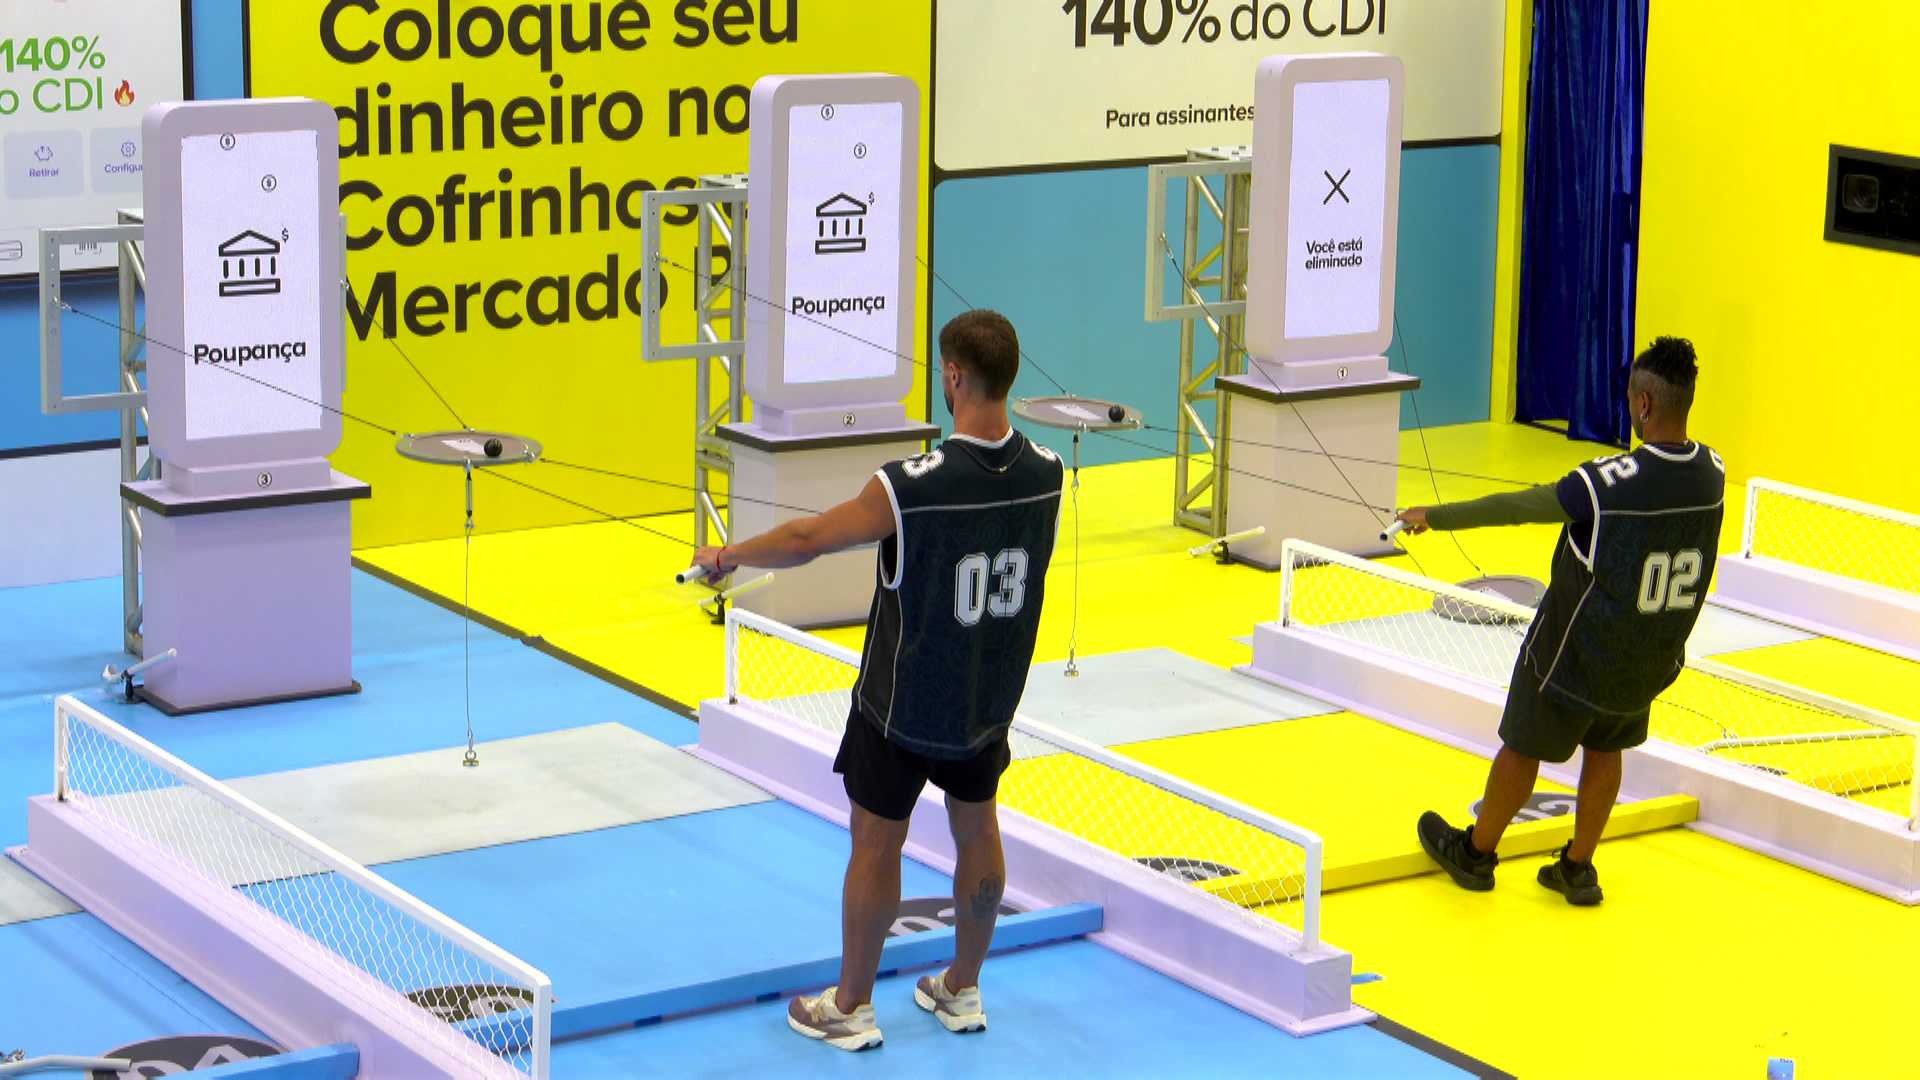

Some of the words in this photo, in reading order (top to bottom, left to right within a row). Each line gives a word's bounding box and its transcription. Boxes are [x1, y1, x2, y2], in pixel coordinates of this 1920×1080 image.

[320, 0, 650, 73] Coloque
[673, 0, 798, 48] seu
[1062, 0, 1221, 48] 140%
[1230, 0, 1291, 41] do
[1303, 0, 1386, 37] CDI
[0, 35, 106, 73] 140%
[32, 76, 104, 113] CDI
[338, 74, 644, 159] dinheiro
[668, 84, 751, 138] no
[1105, 109, 1150, 129] Para
[1156, 104, 1255, 126] assinantes
[339, 167, 699, 251] Cofrinhos
[1305, 253, 1363, 270] eliminado
[1306, 238, 1336, 255] Você
[1338, 236, 1363, 252] está
[345, 253, 668, 341] Mercado
[792, 296, 885, 318] Poupança
[193, 341, 307, 366] Poupança
[1591, 454, 1640, 488] 2
[953, 547, 1030, 627] 03
[1636, 548, 1704, 615] 02
